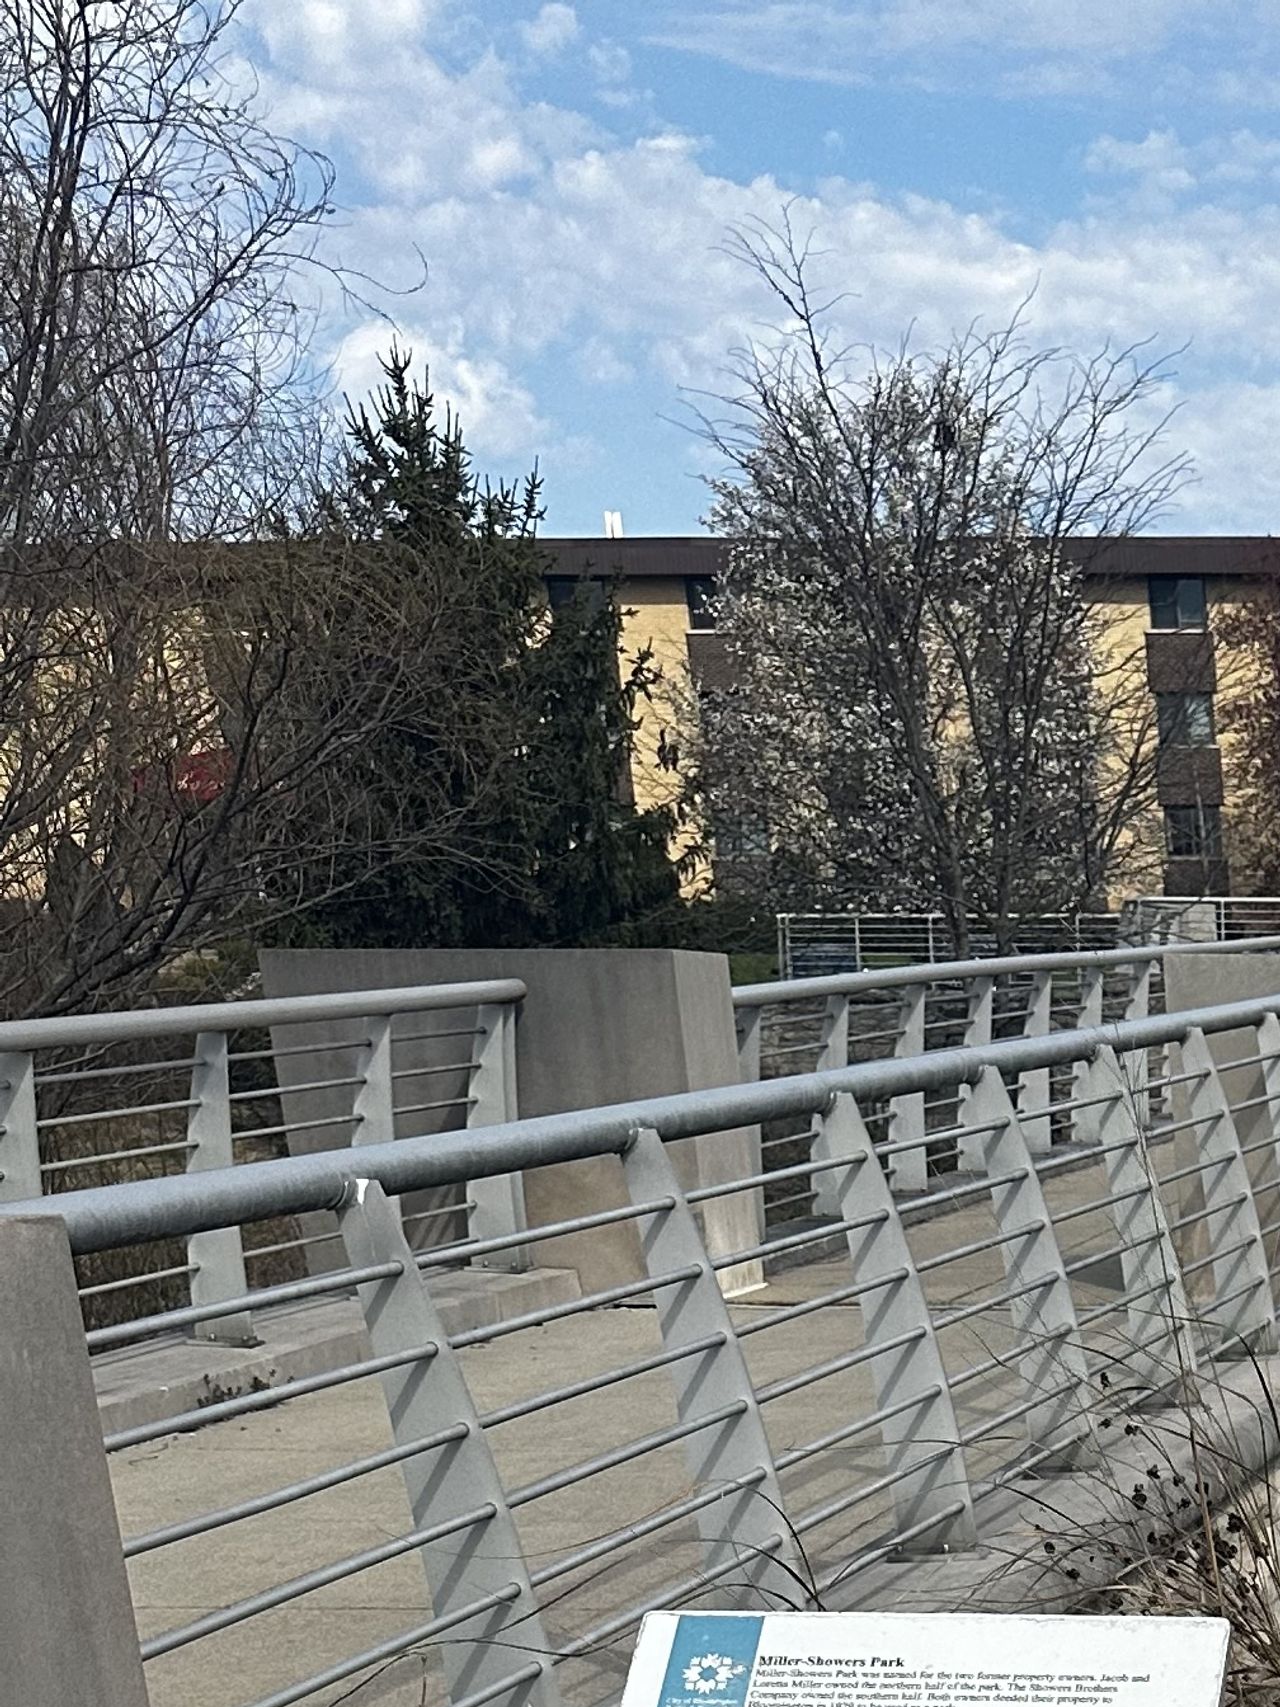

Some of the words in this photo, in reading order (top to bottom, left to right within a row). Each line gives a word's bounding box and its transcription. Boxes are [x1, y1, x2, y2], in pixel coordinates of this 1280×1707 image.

[759, 1655, 866, 1667] Miller-Showers
[870, 1657, 905, 1668] Park
[836, 1670, 858, 1679] Park
[938, 1671, 952, 1680] the
[1012, 1672, 1056, 1684] property
[1100, 1673, 1130, 1682] Jacob
[791, 1679, 822, 1688] Miller
[1006, 1682, 1026, 1691] The
[1056, 1694, 1100, 1705] property
